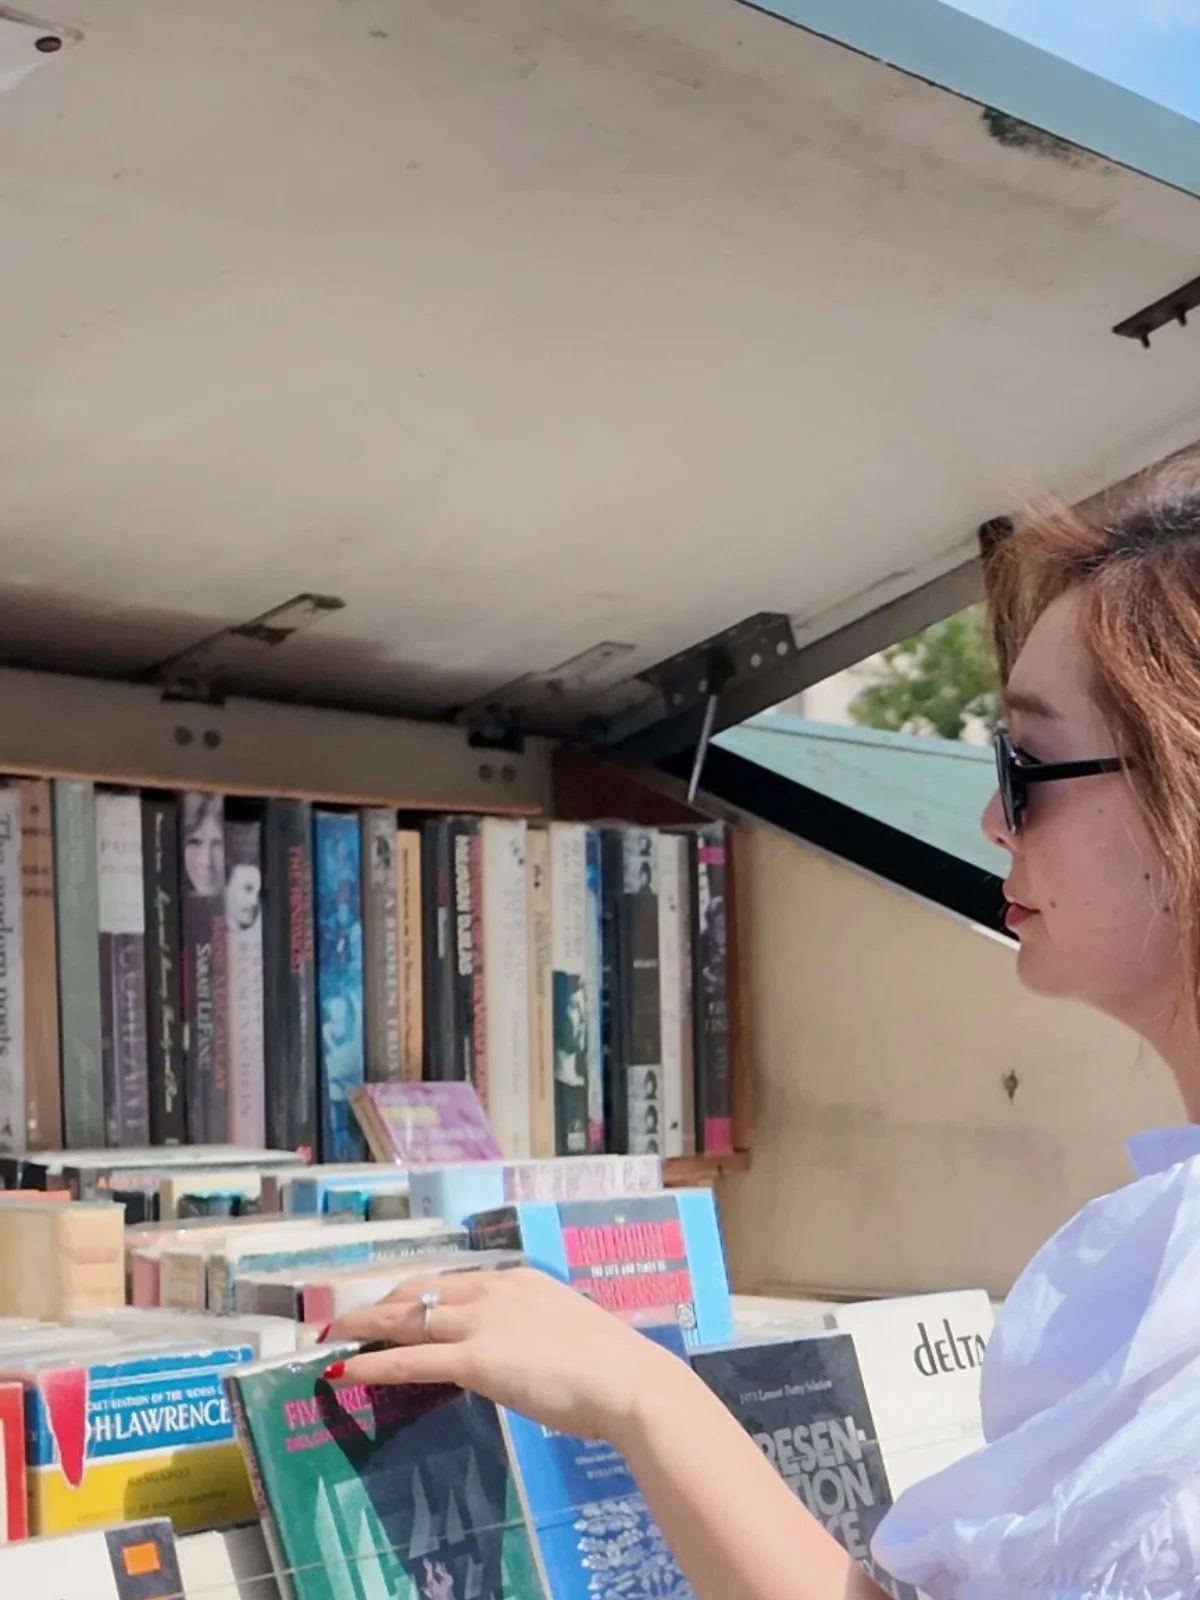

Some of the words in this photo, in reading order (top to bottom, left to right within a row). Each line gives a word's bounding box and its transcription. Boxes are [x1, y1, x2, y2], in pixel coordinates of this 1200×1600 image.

[385, 917, 398, 1008] BROKEN
[621, 1263, 635, 1275] AND
[150, 1391, 163, 1404] OF
[166, 1389, 182, 1402] THE
[284, 1397, 330, 1430] FIVE
[332, 1383, 390, 1415] IRISH
[751, 1415, 866, 1478] RESEN-
